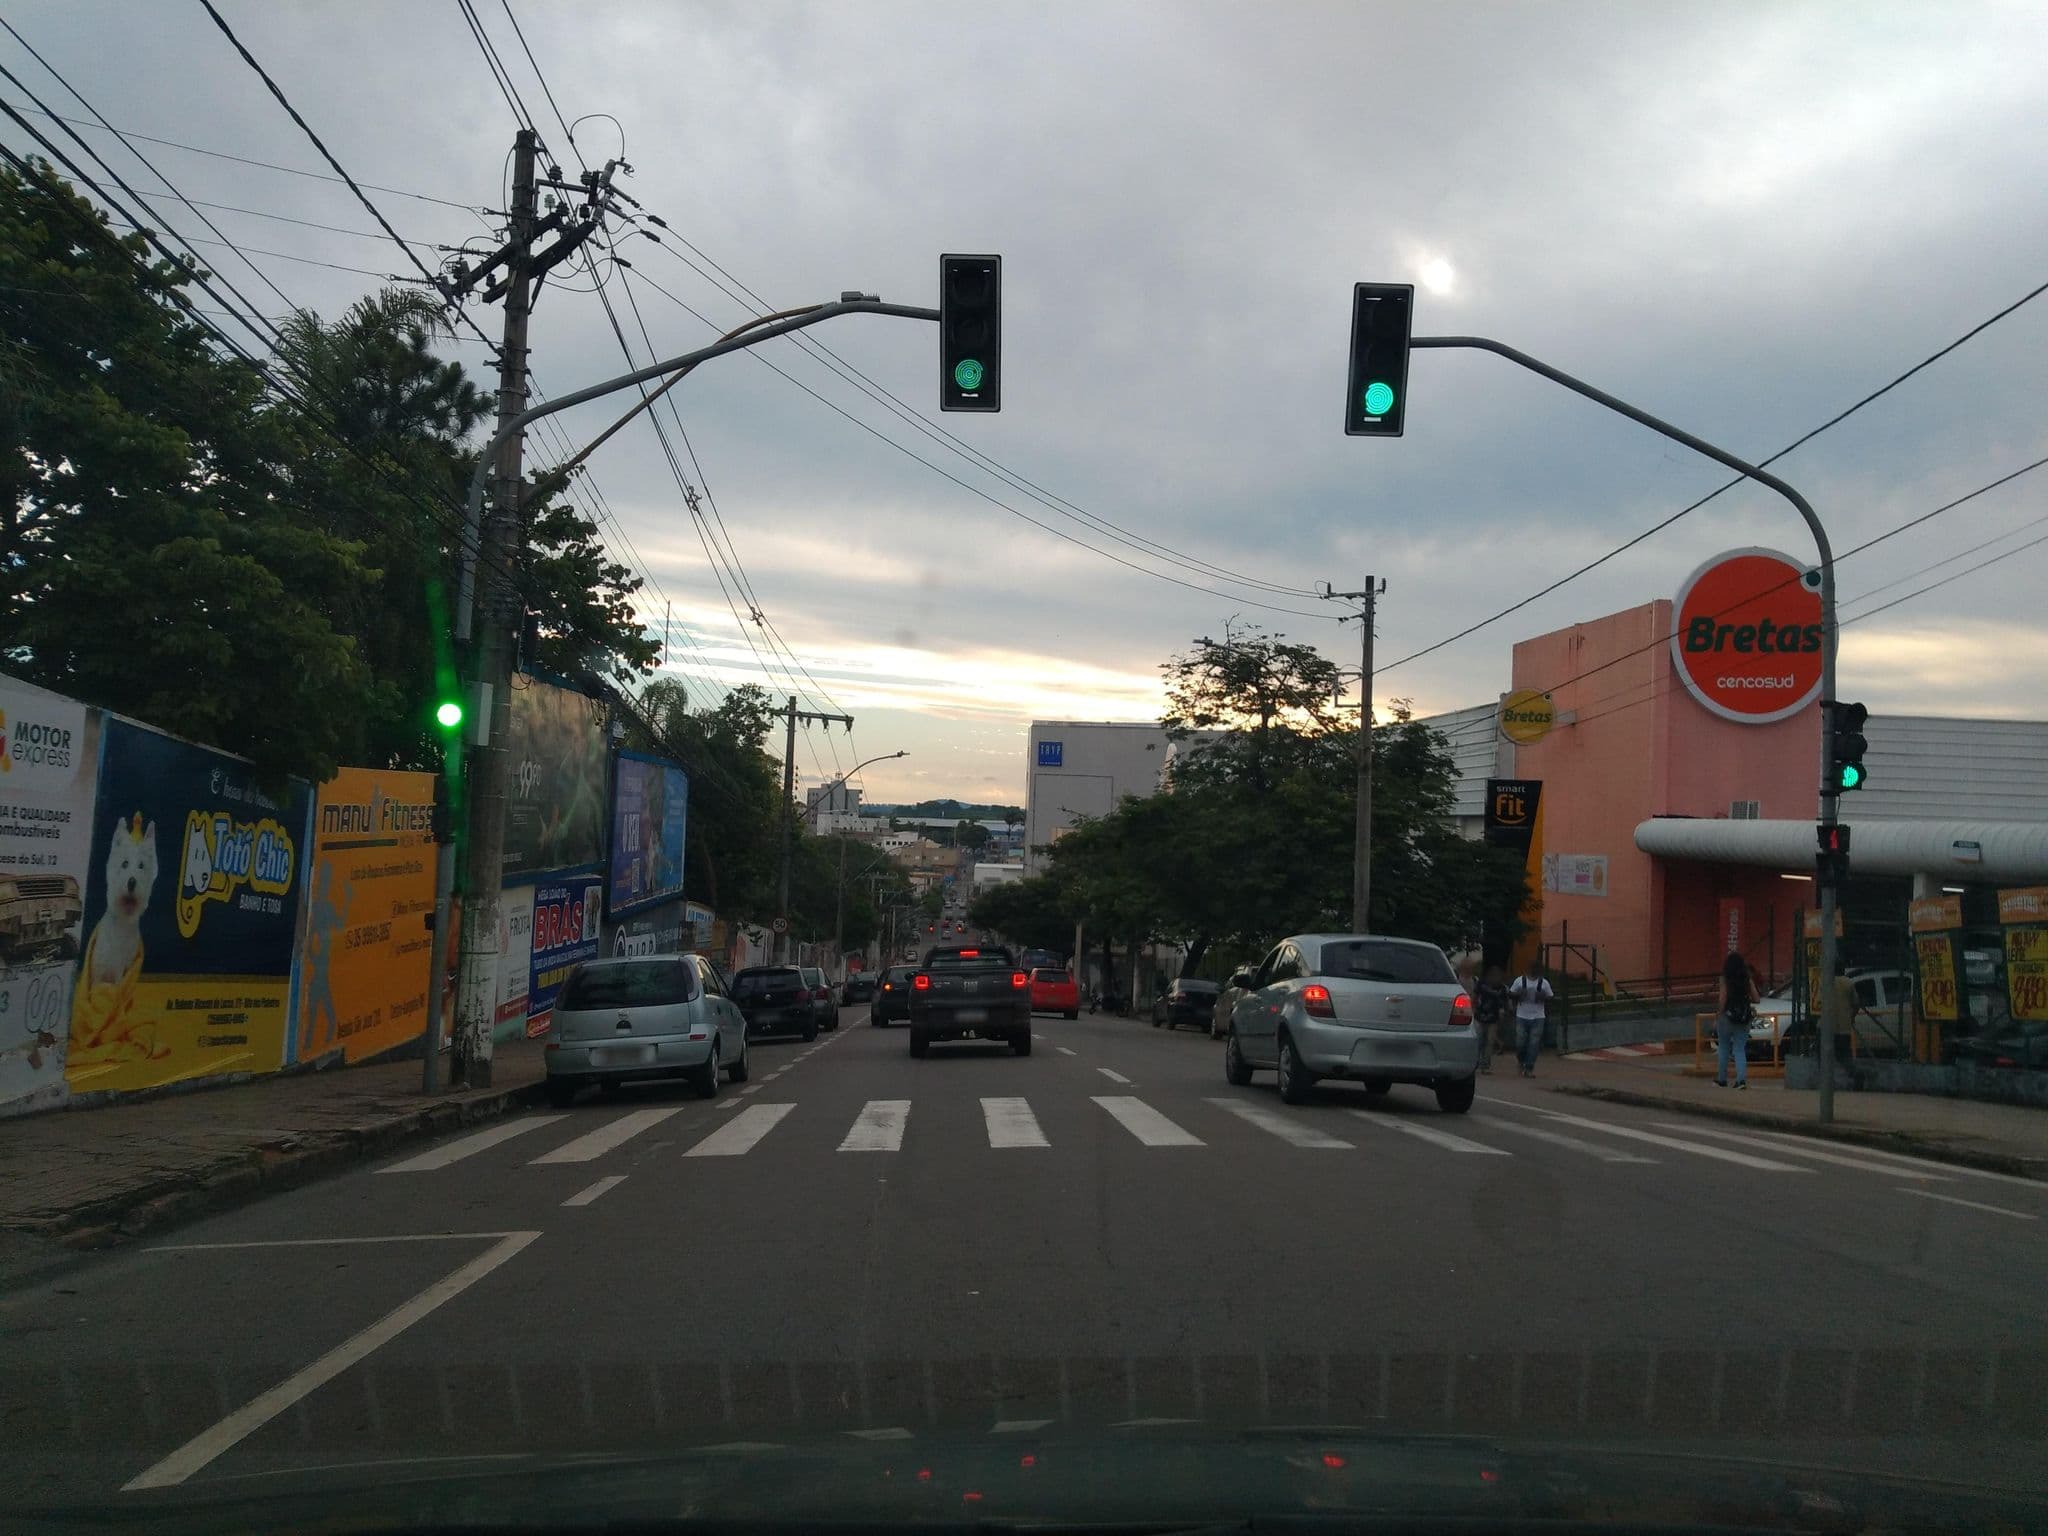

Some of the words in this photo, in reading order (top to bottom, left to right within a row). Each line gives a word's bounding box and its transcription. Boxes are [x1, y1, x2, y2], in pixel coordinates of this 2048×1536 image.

[1685, 616, 1824, 654] Bretas
[1717, 674, 1794, 689] cencosud
[1504, 708, 1552, 723] Bretas
[14, 721, 71, 750] MOTOR
[12, 743, 71, 769] express
[1496, 785, 1526, 793] smart
[20, 807, 71, 824] QUALIDADE
[1496, 793, 1525, 816] fit
[254, 831, 290, 885] Chic
[533, 892, 582, 953] BRÁS
[775, 920, 786, 929] 50
